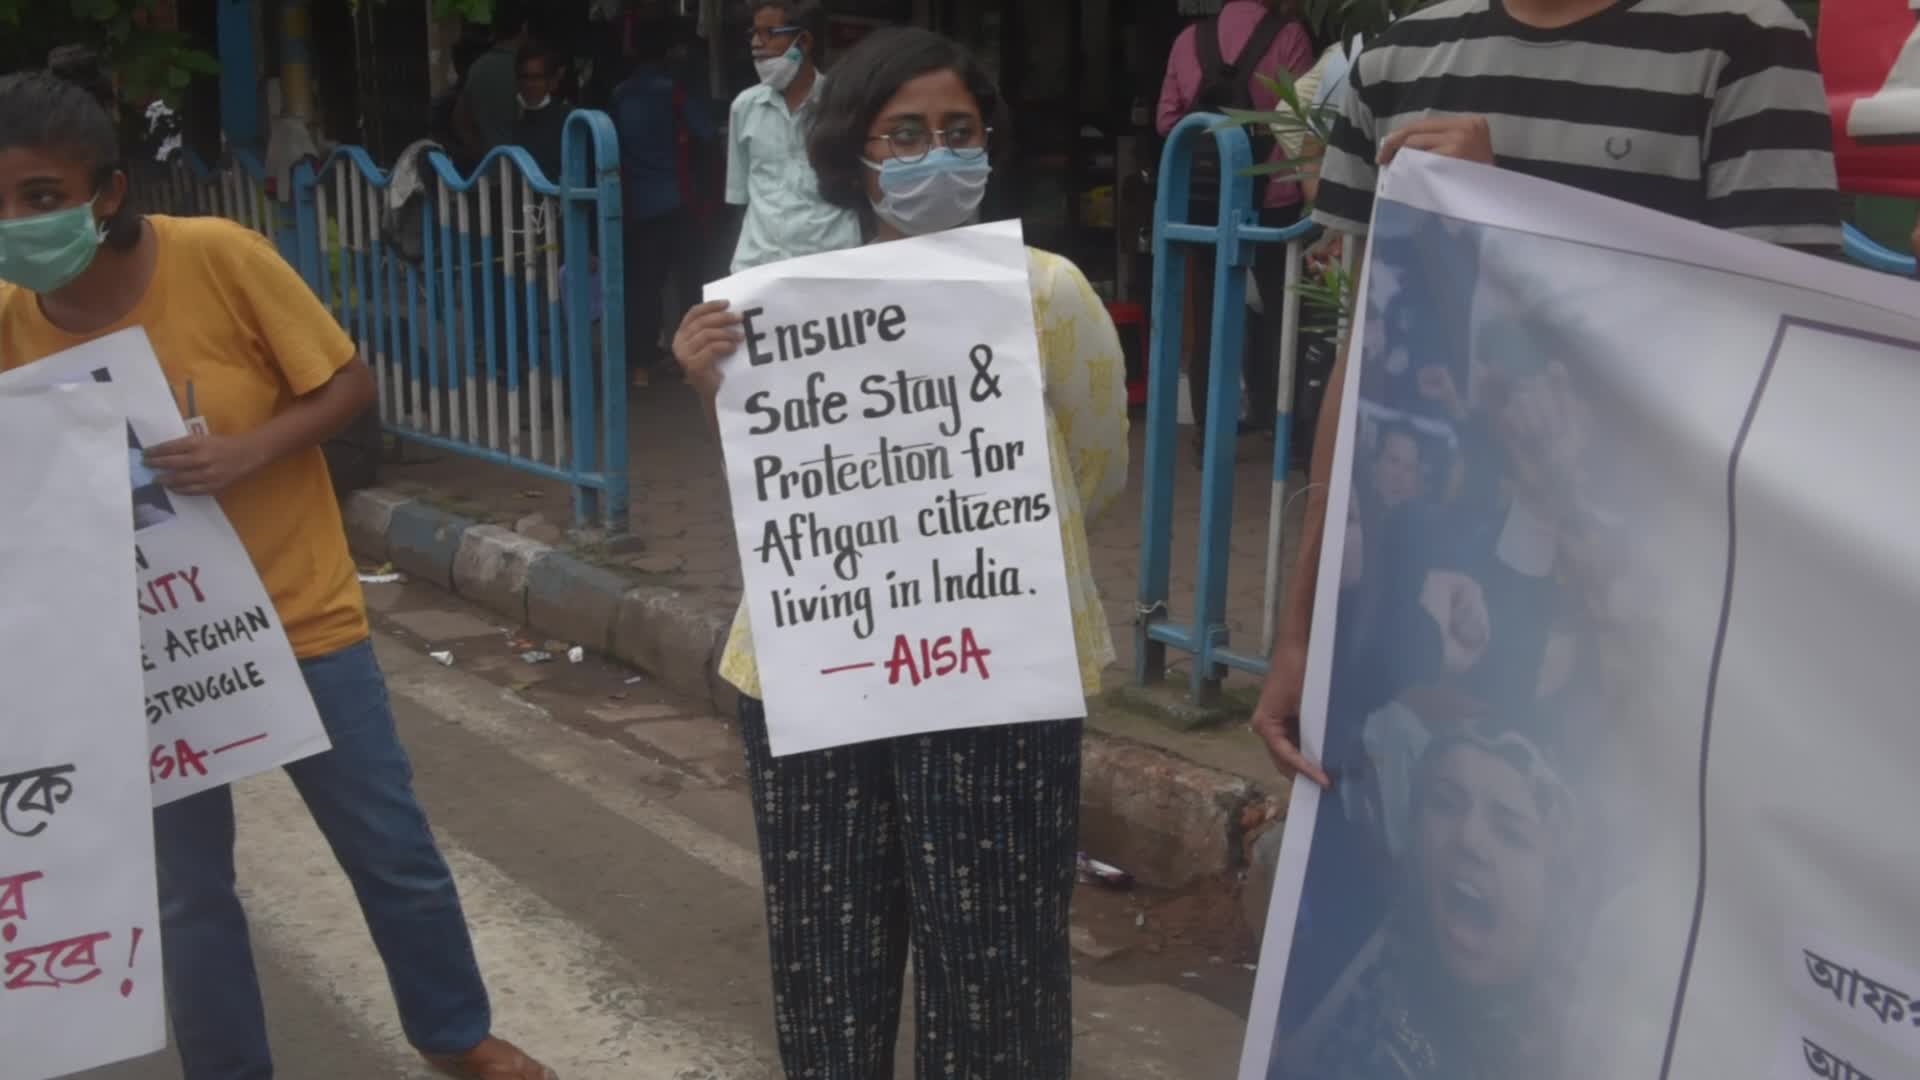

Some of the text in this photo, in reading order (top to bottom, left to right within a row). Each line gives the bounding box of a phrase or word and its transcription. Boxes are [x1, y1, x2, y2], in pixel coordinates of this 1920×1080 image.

[742, 304, 906, 366] Ensure
[744, 344, 1002, 436] Safe Stay &
[753, 427, 1024, 501] Protection for
[753, 489, 1051, 581] Afhgan citizens
[771, 547, 1037, 639] living in India.
[164, 605, 270, 662] AFGHAN
[884, 627, 991, 686] AISA
[145, 661, 265, 724] STRUGGLE
